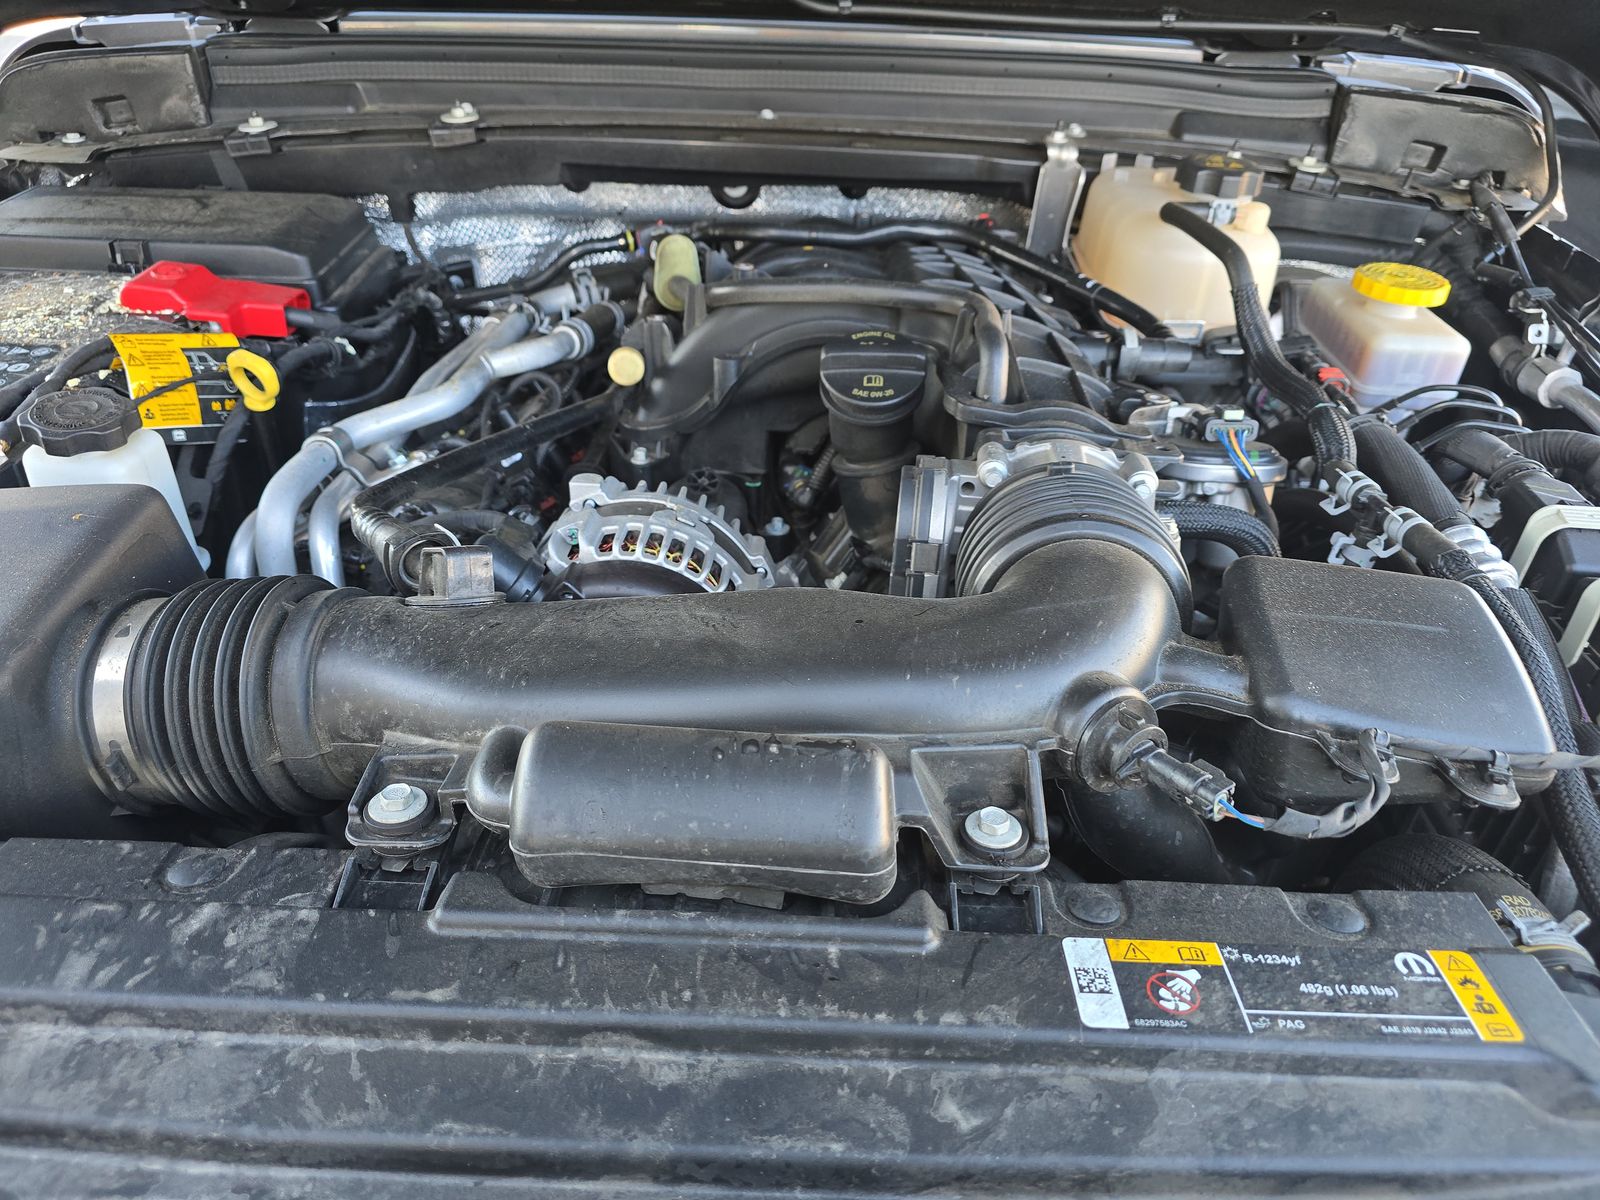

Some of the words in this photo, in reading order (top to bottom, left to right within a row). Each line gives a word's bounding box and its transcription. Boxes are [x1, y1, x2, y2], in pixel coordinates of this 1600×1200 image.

[851, 331, 882, 340] ENGINE
[883, 332, 896, 340] OIL
[851, 388, 869, 397] SAE
[1501, 894, 1532, 907] RAD
[1242, 953, 1302, 967] R-1234yf
[1299, 983, 1333, 996] 482g
[1335, 984, 1369, 997] (1.06
[1371, 984, 1399, 998] lbs)
[1277, 1019, 1306, 1030] PAG
[1381, 1025, 1400, 1034] SAE
